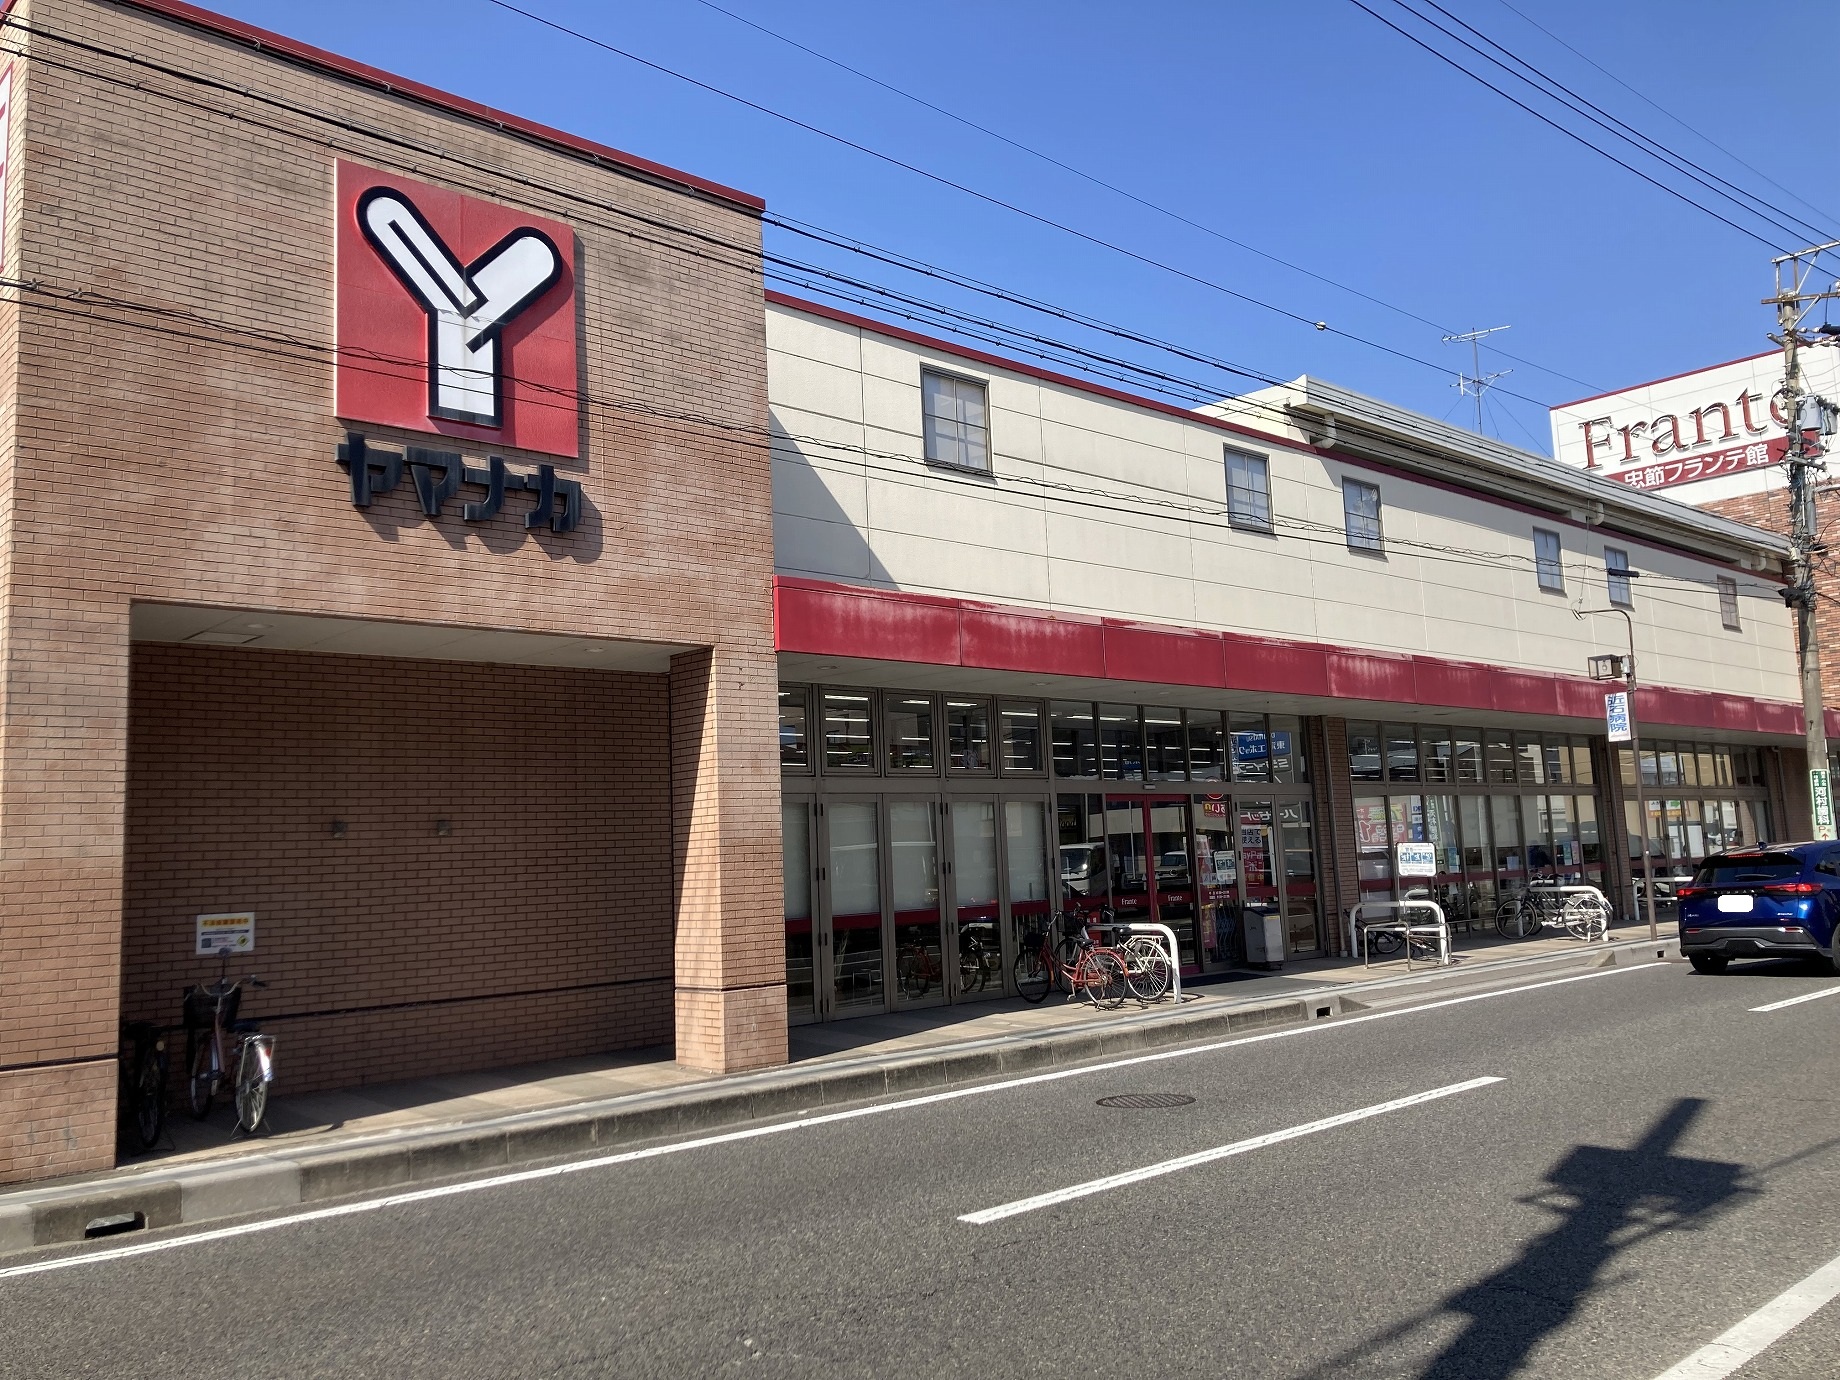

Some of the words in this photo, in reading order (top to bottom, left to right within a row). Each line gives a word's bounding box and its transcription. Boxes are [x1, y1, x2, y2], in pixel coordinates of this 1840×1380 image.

[336, 432, 582, 533] ヤマナカ
[1624, 443, 1770, 488] 忠節フランテ館
[1608, 694, 1627, 733] 近石病院
[1815, 786, 1830, 825] 河村歯科
